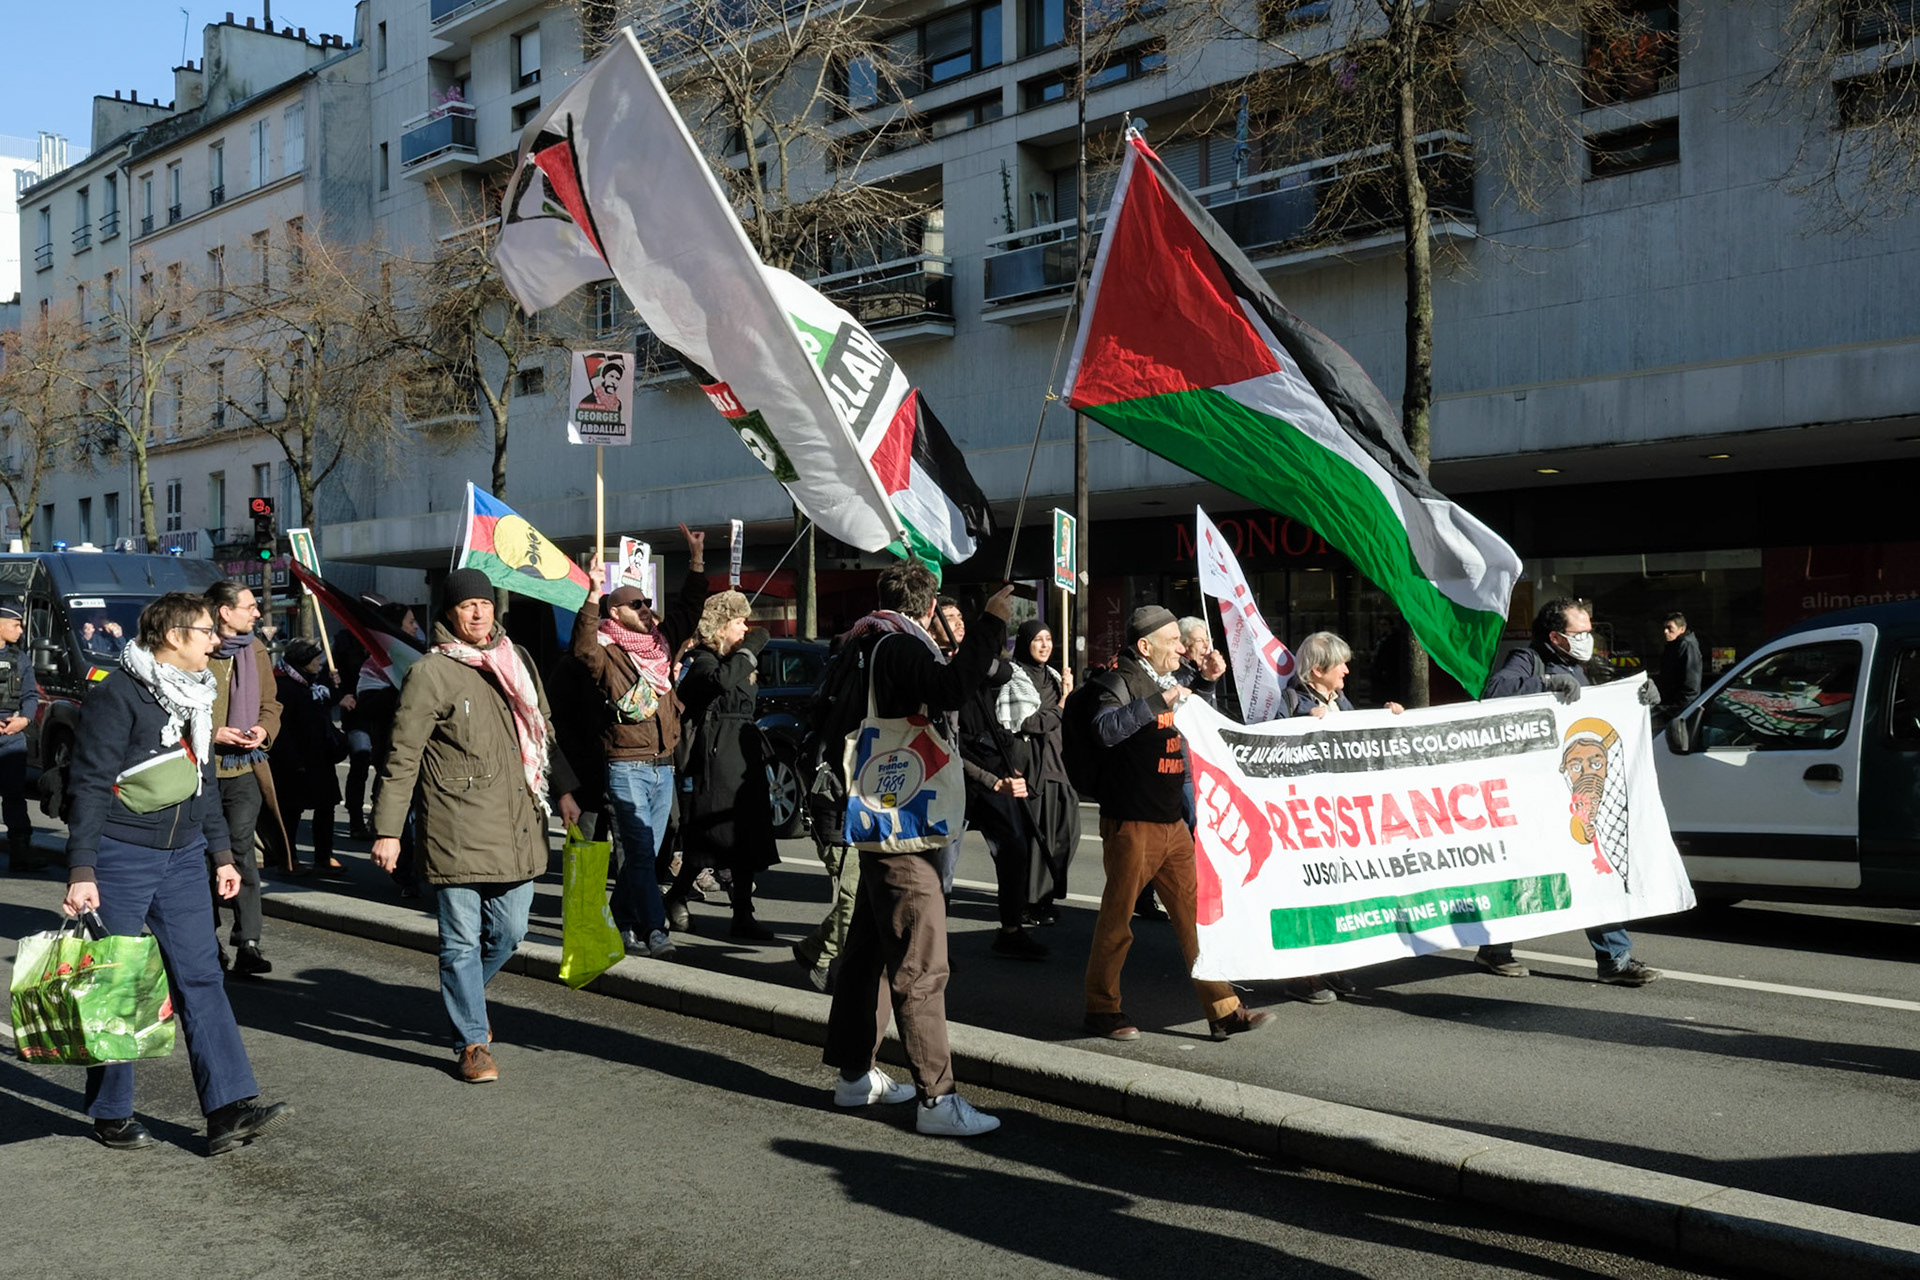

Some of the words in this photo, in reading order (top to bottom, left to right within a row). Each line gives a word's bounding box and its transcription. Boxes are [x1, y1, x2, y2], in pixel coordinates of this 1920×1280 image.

[577, 411, 619, 422] GEORGES
[581, 423, 625, 434] ABDALLAH
[1249, 746, 1269, 764] AU
[1332, 738, 1344, 760] À
[1342, 737, 1381, 760] TOUS
[1381, 736, 1411, 757] LES
[1412, 719, 1550, 754] COLONIALISMES
[877, 761, 909, 773] France
[888, 755, 898, 763] in
[874, 774, 906, 794] 1989
[1264, 777, 1518, 851] RÉSSTANCE
[1355, 859, 1380, 880] LA
[1380, 842, 1496, 879] LBÉRATION
[1336, 910, 1381, 933] GENCE
[1441, 898, 1477, 916] PARIS
[1476, 895, 1491, 911] 18
